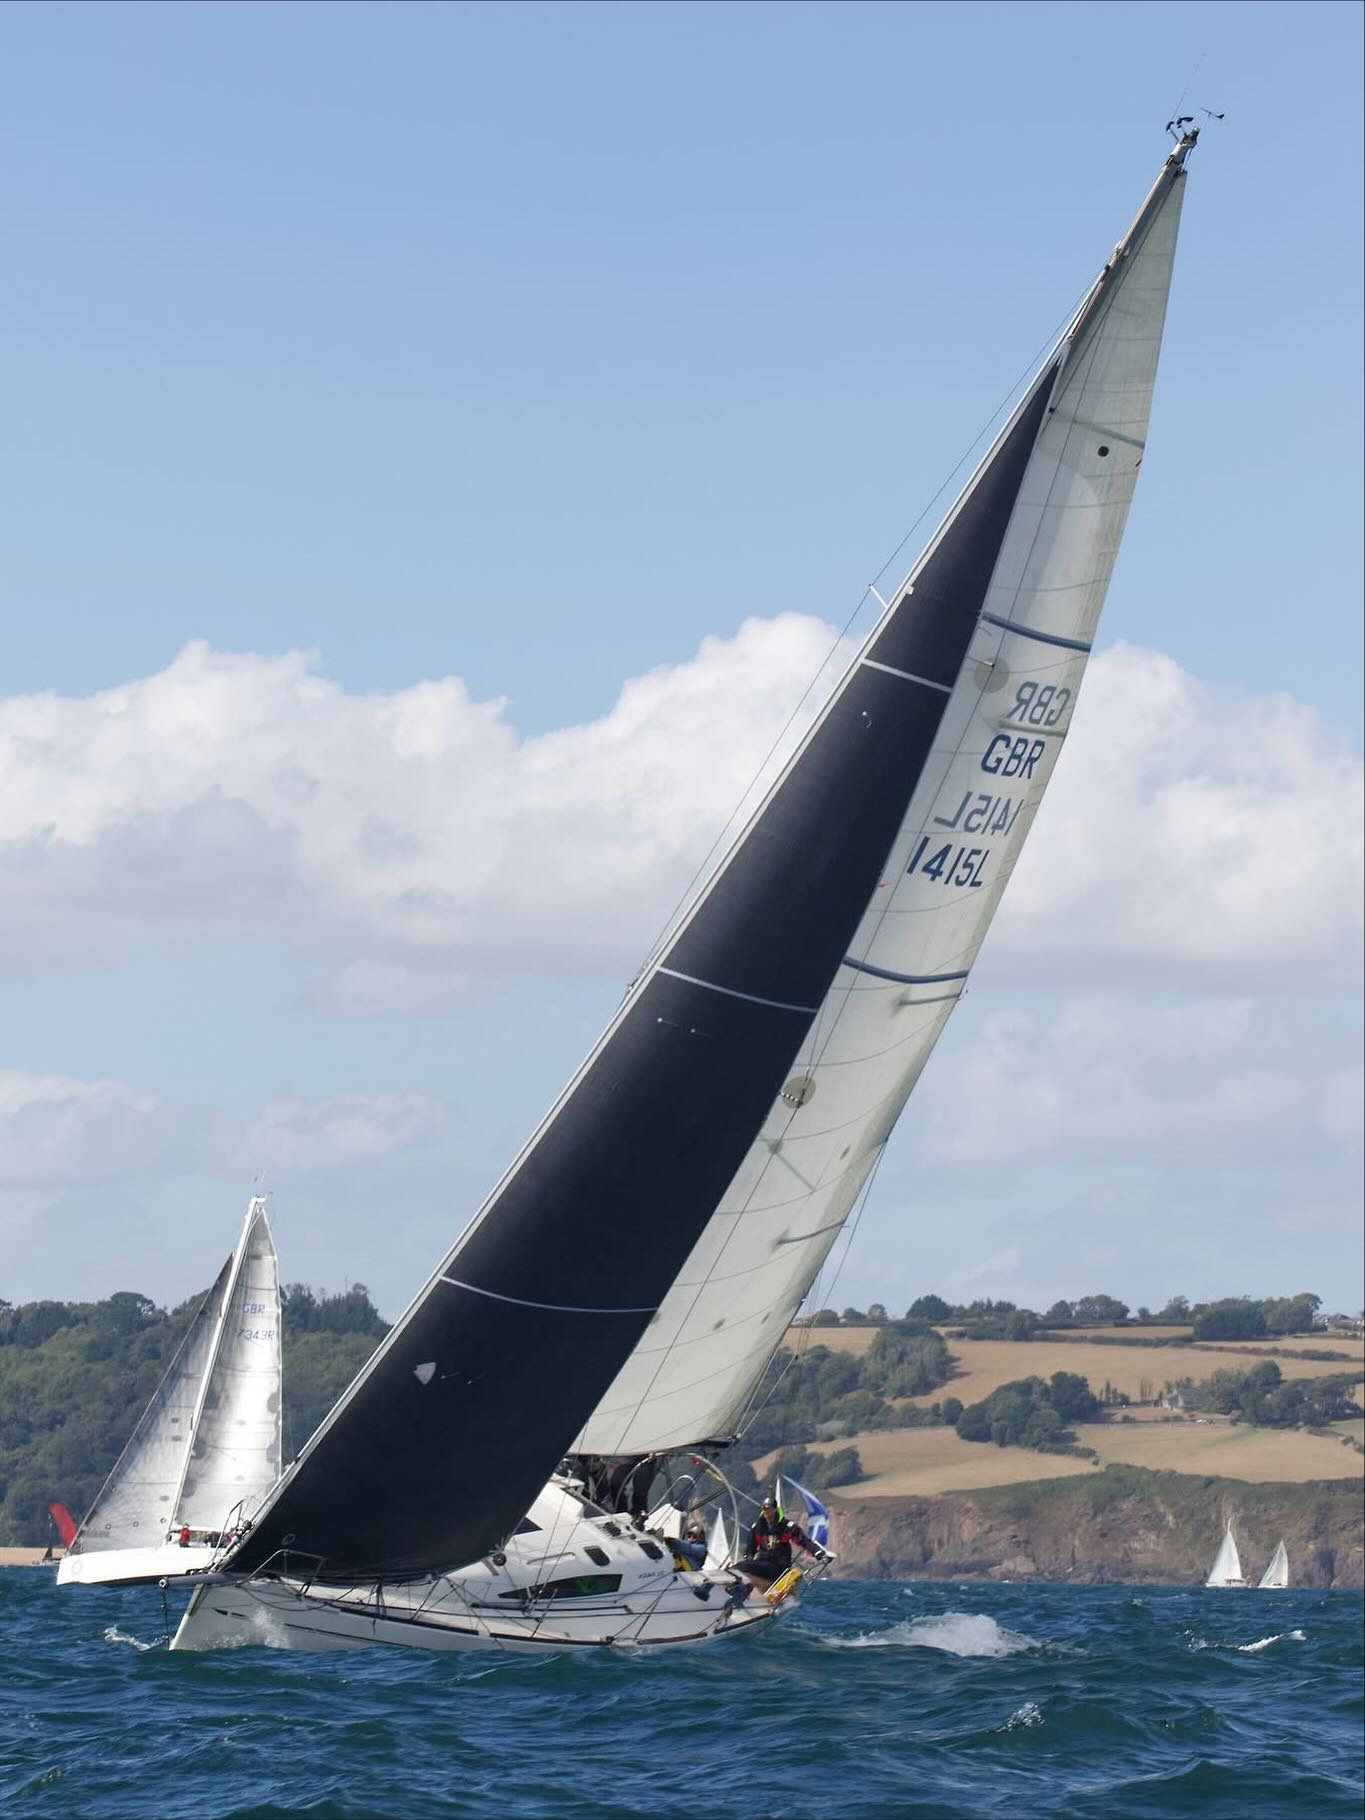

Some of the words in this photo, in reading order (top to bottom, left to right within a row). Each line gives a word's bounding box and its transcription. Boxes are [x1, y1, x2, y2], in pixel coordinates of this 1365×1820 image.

[981, 734, 1045, 779] GBR
[906, 836, 989, 887] 1415L
[242, 1303, 266, 1314] GBR
